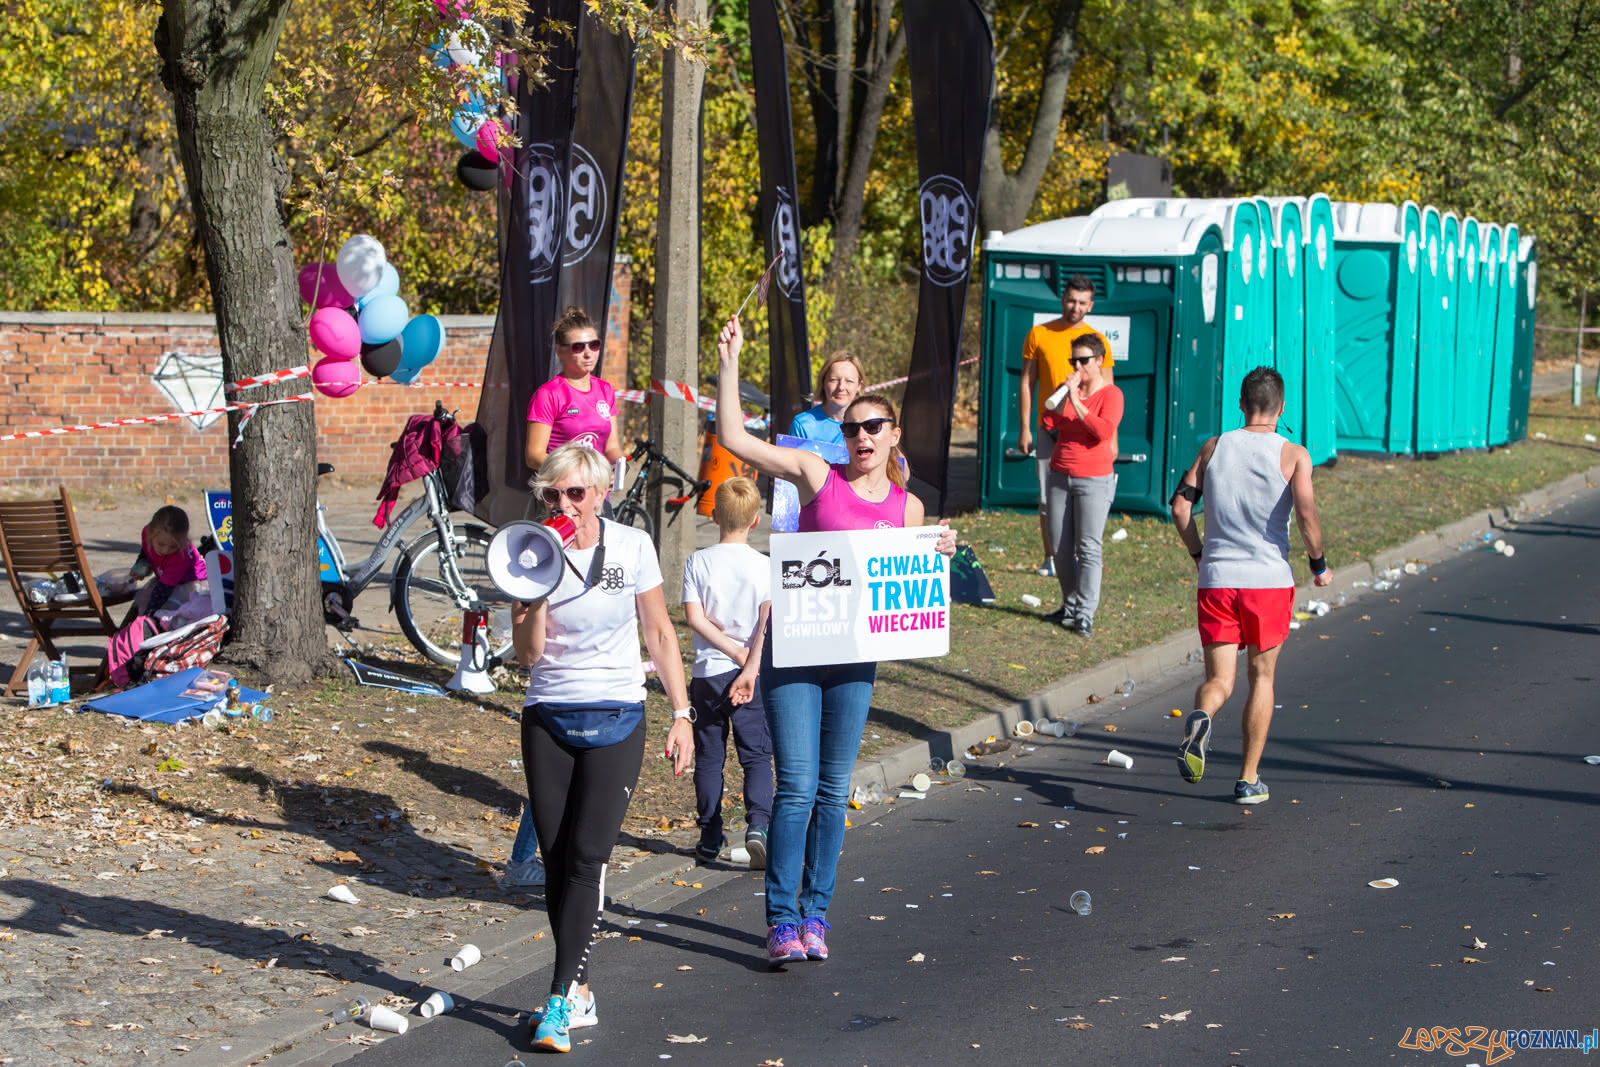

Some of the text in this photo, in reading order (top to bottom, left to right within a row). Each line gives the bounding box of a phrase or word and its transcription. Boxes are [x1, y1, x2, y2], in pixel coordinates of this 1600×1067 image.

[214, 500, 227, 509] citi
[782, 550, 852, 590] BÓL
[867, 553, 944, 578] CHWAŁA
[783, 590, 850, 623] JEST
[868, 578, 946, 611] TRWA
[783, 621, 850, 638] CHWILOWY
[868, 611, 946, 634] WIECZNIE
